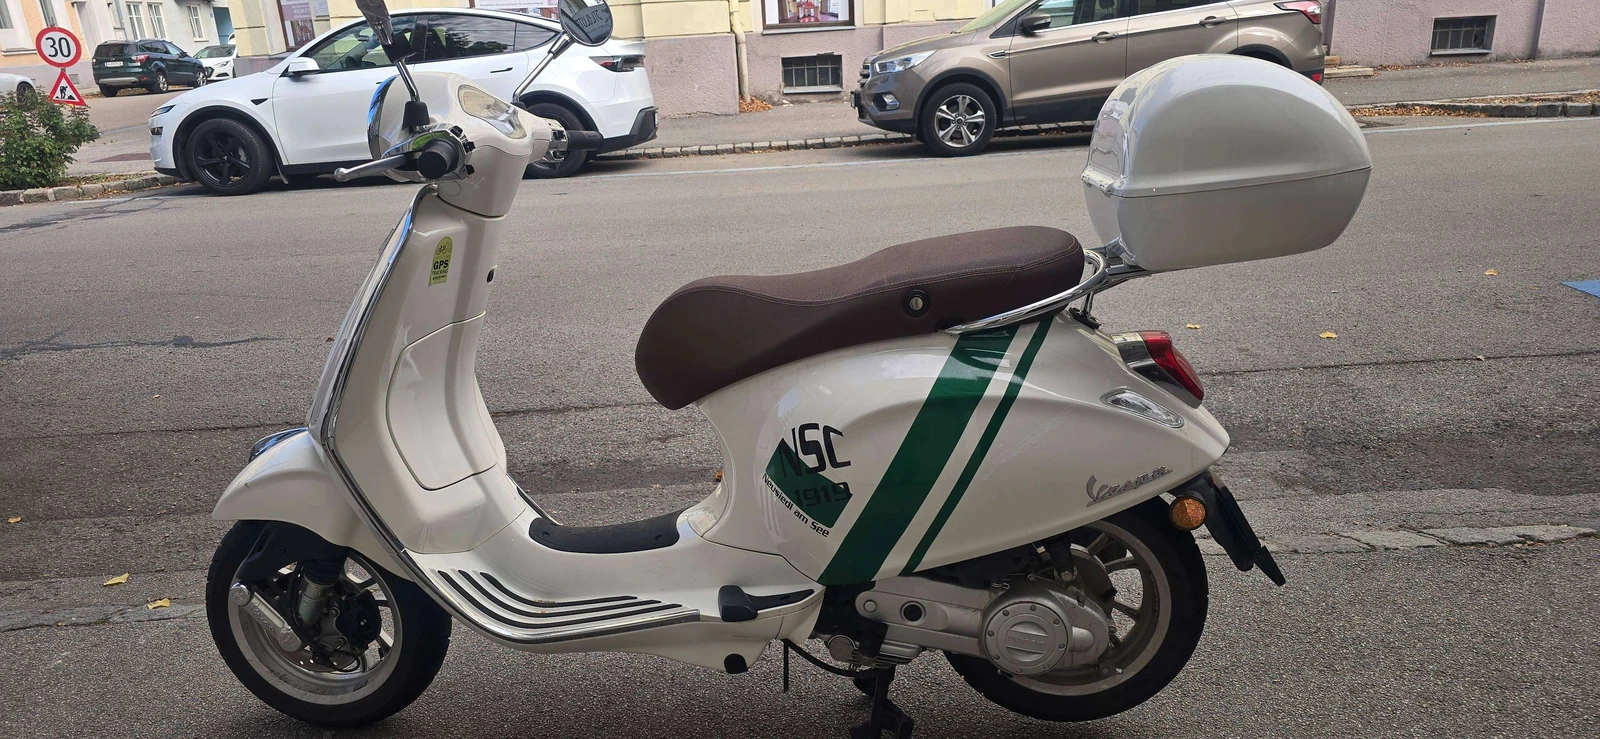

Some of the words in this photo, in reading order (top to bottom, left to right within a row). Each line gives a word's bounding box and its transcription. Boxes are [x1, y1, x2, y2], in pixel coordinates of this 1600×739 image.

[45, 37, 71, 58] 30
[433, 259, 449, 270] GPS
[779, 423, 852, 479] NSC
[762, 473, 794, 511] Neusiedl
[794, 509, 809, 524] am
[810, 521, 830, 538] See
[794, 482, 852, 508] 1919
